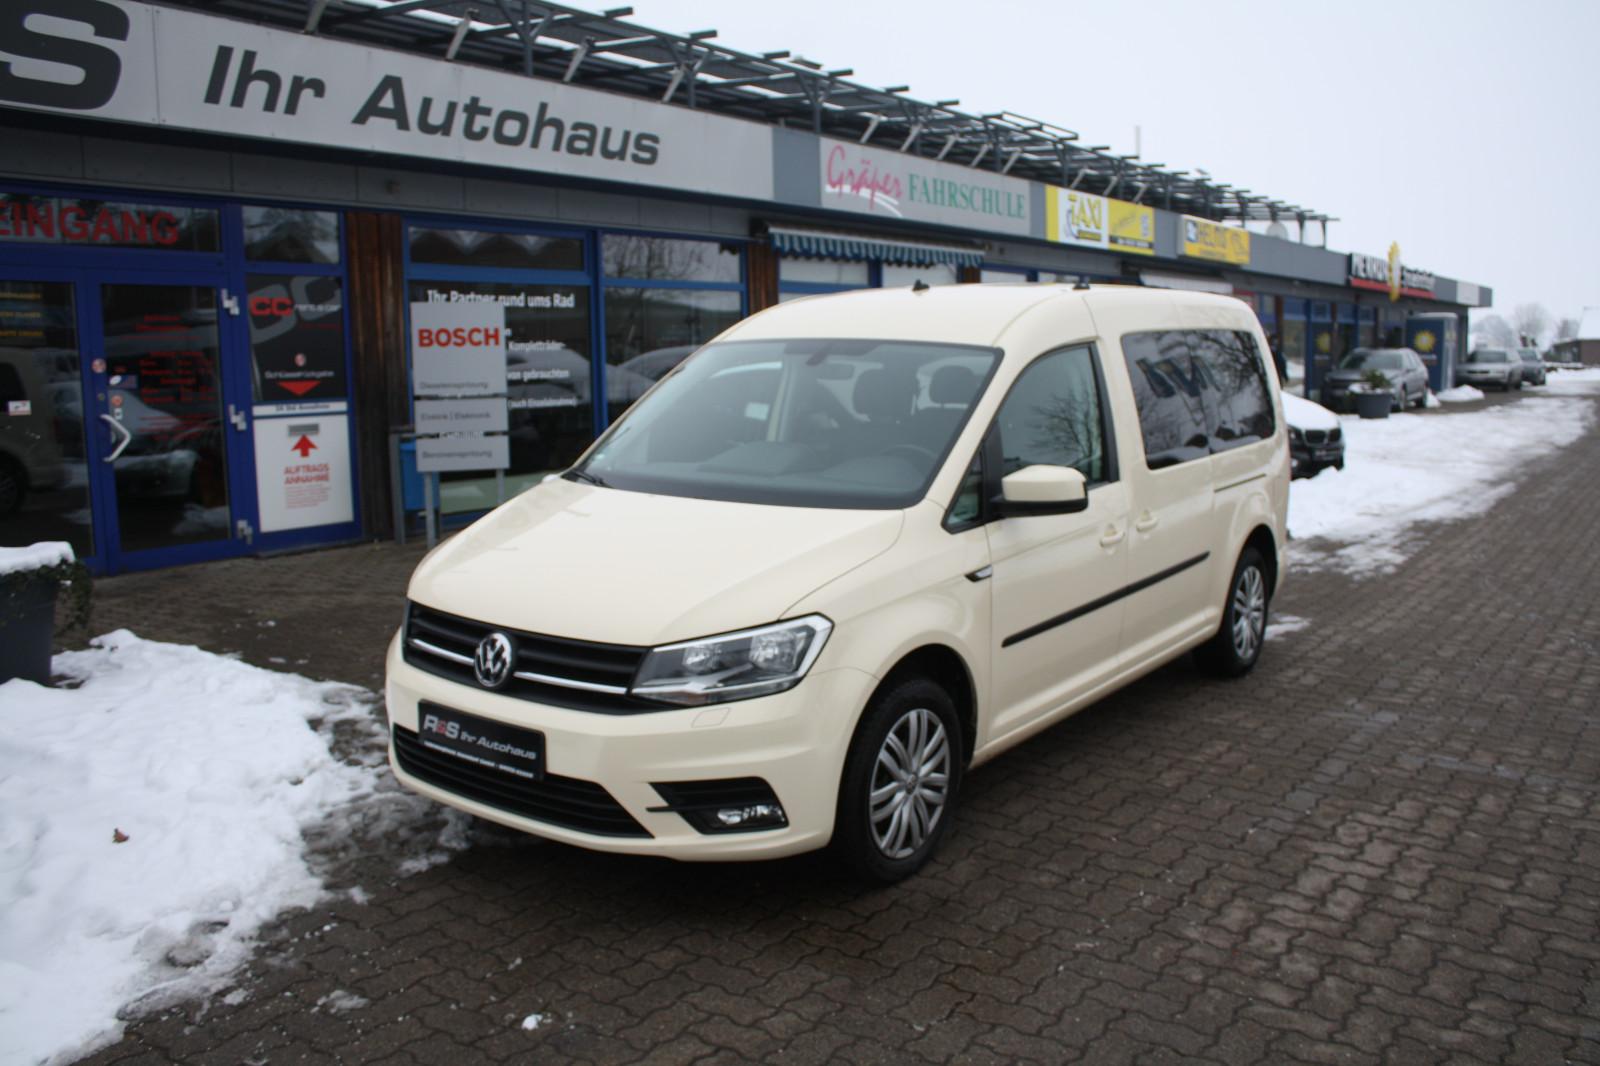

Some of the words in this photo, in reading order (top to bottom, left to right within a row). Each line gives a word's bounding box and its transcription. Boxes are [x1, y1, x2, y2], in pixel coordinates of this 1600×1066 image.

[203, 44, 326, 116] Ihr
[350, 74, 661, 166] Autohaus
[907, 172, 1027, 219] FAHRSCHULE
[426, 289, 448, 303] Ihr
[450, 290, 497, 303] Partner
[498, 292, 525, 307] rund
[528, 294, 551, 308] ums
[552, 293, 575, 308] Rad
[417, 327, 500, 348] BOSCH
[477, 736, 537, 760] Autohaus
